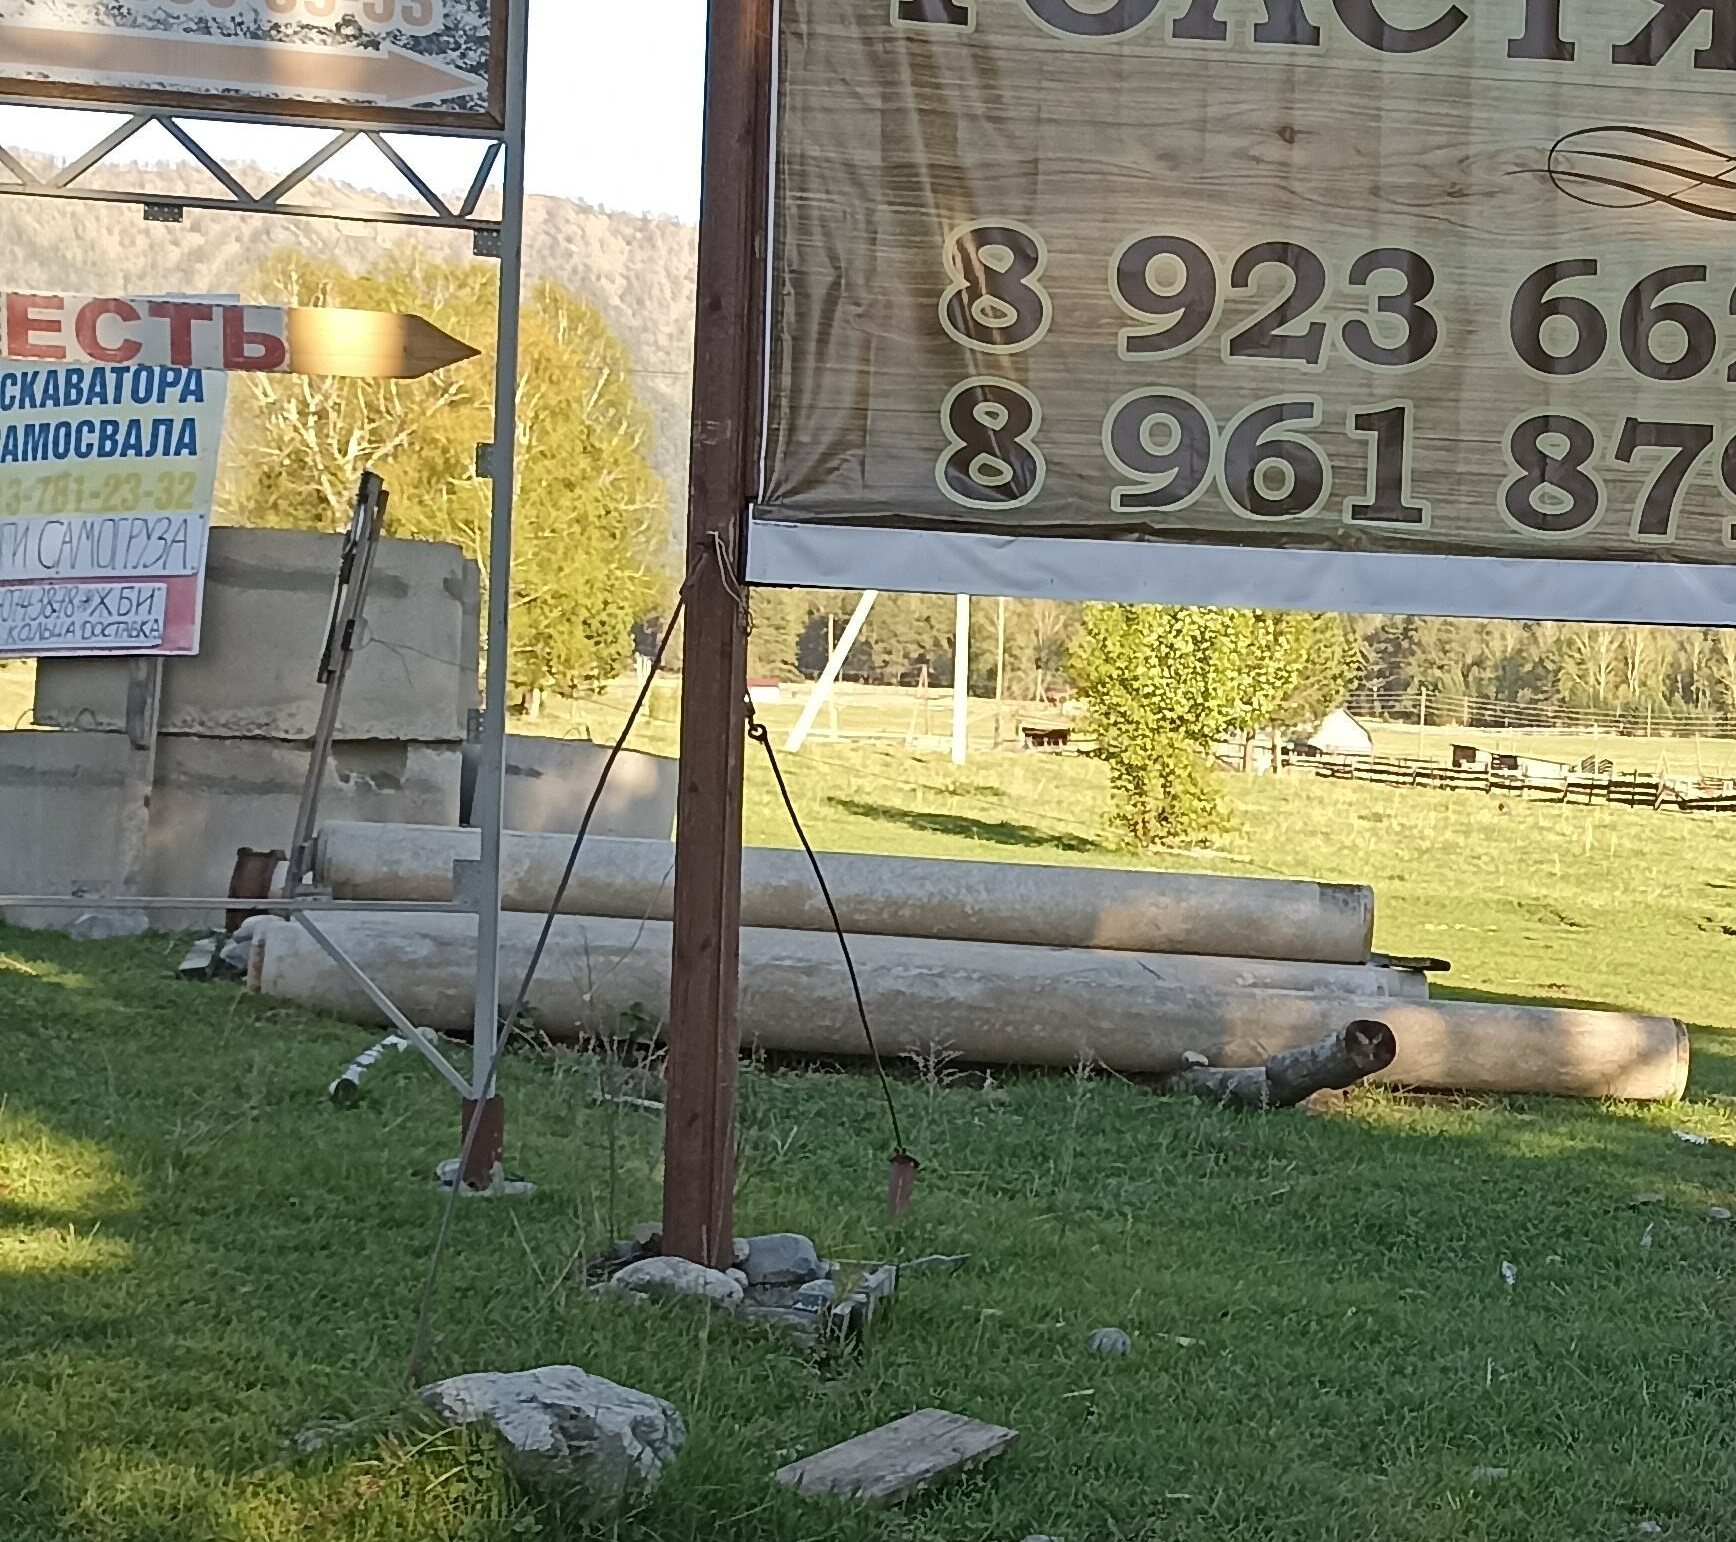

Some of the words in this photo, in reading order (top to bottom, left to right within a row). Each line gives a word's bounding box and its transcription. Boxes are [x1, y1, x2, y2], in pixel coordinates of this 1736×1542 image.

[6, 292, 287, 370] ЕСТЬ
[945, 226, 1045, 347] 8
[1116, 235, 1440, 366] 923
[0, 365, 205, 410] СКАВАТОРА
[942, 384, 1038, 503] 8
[1110, 394, 1425, 525] 961
